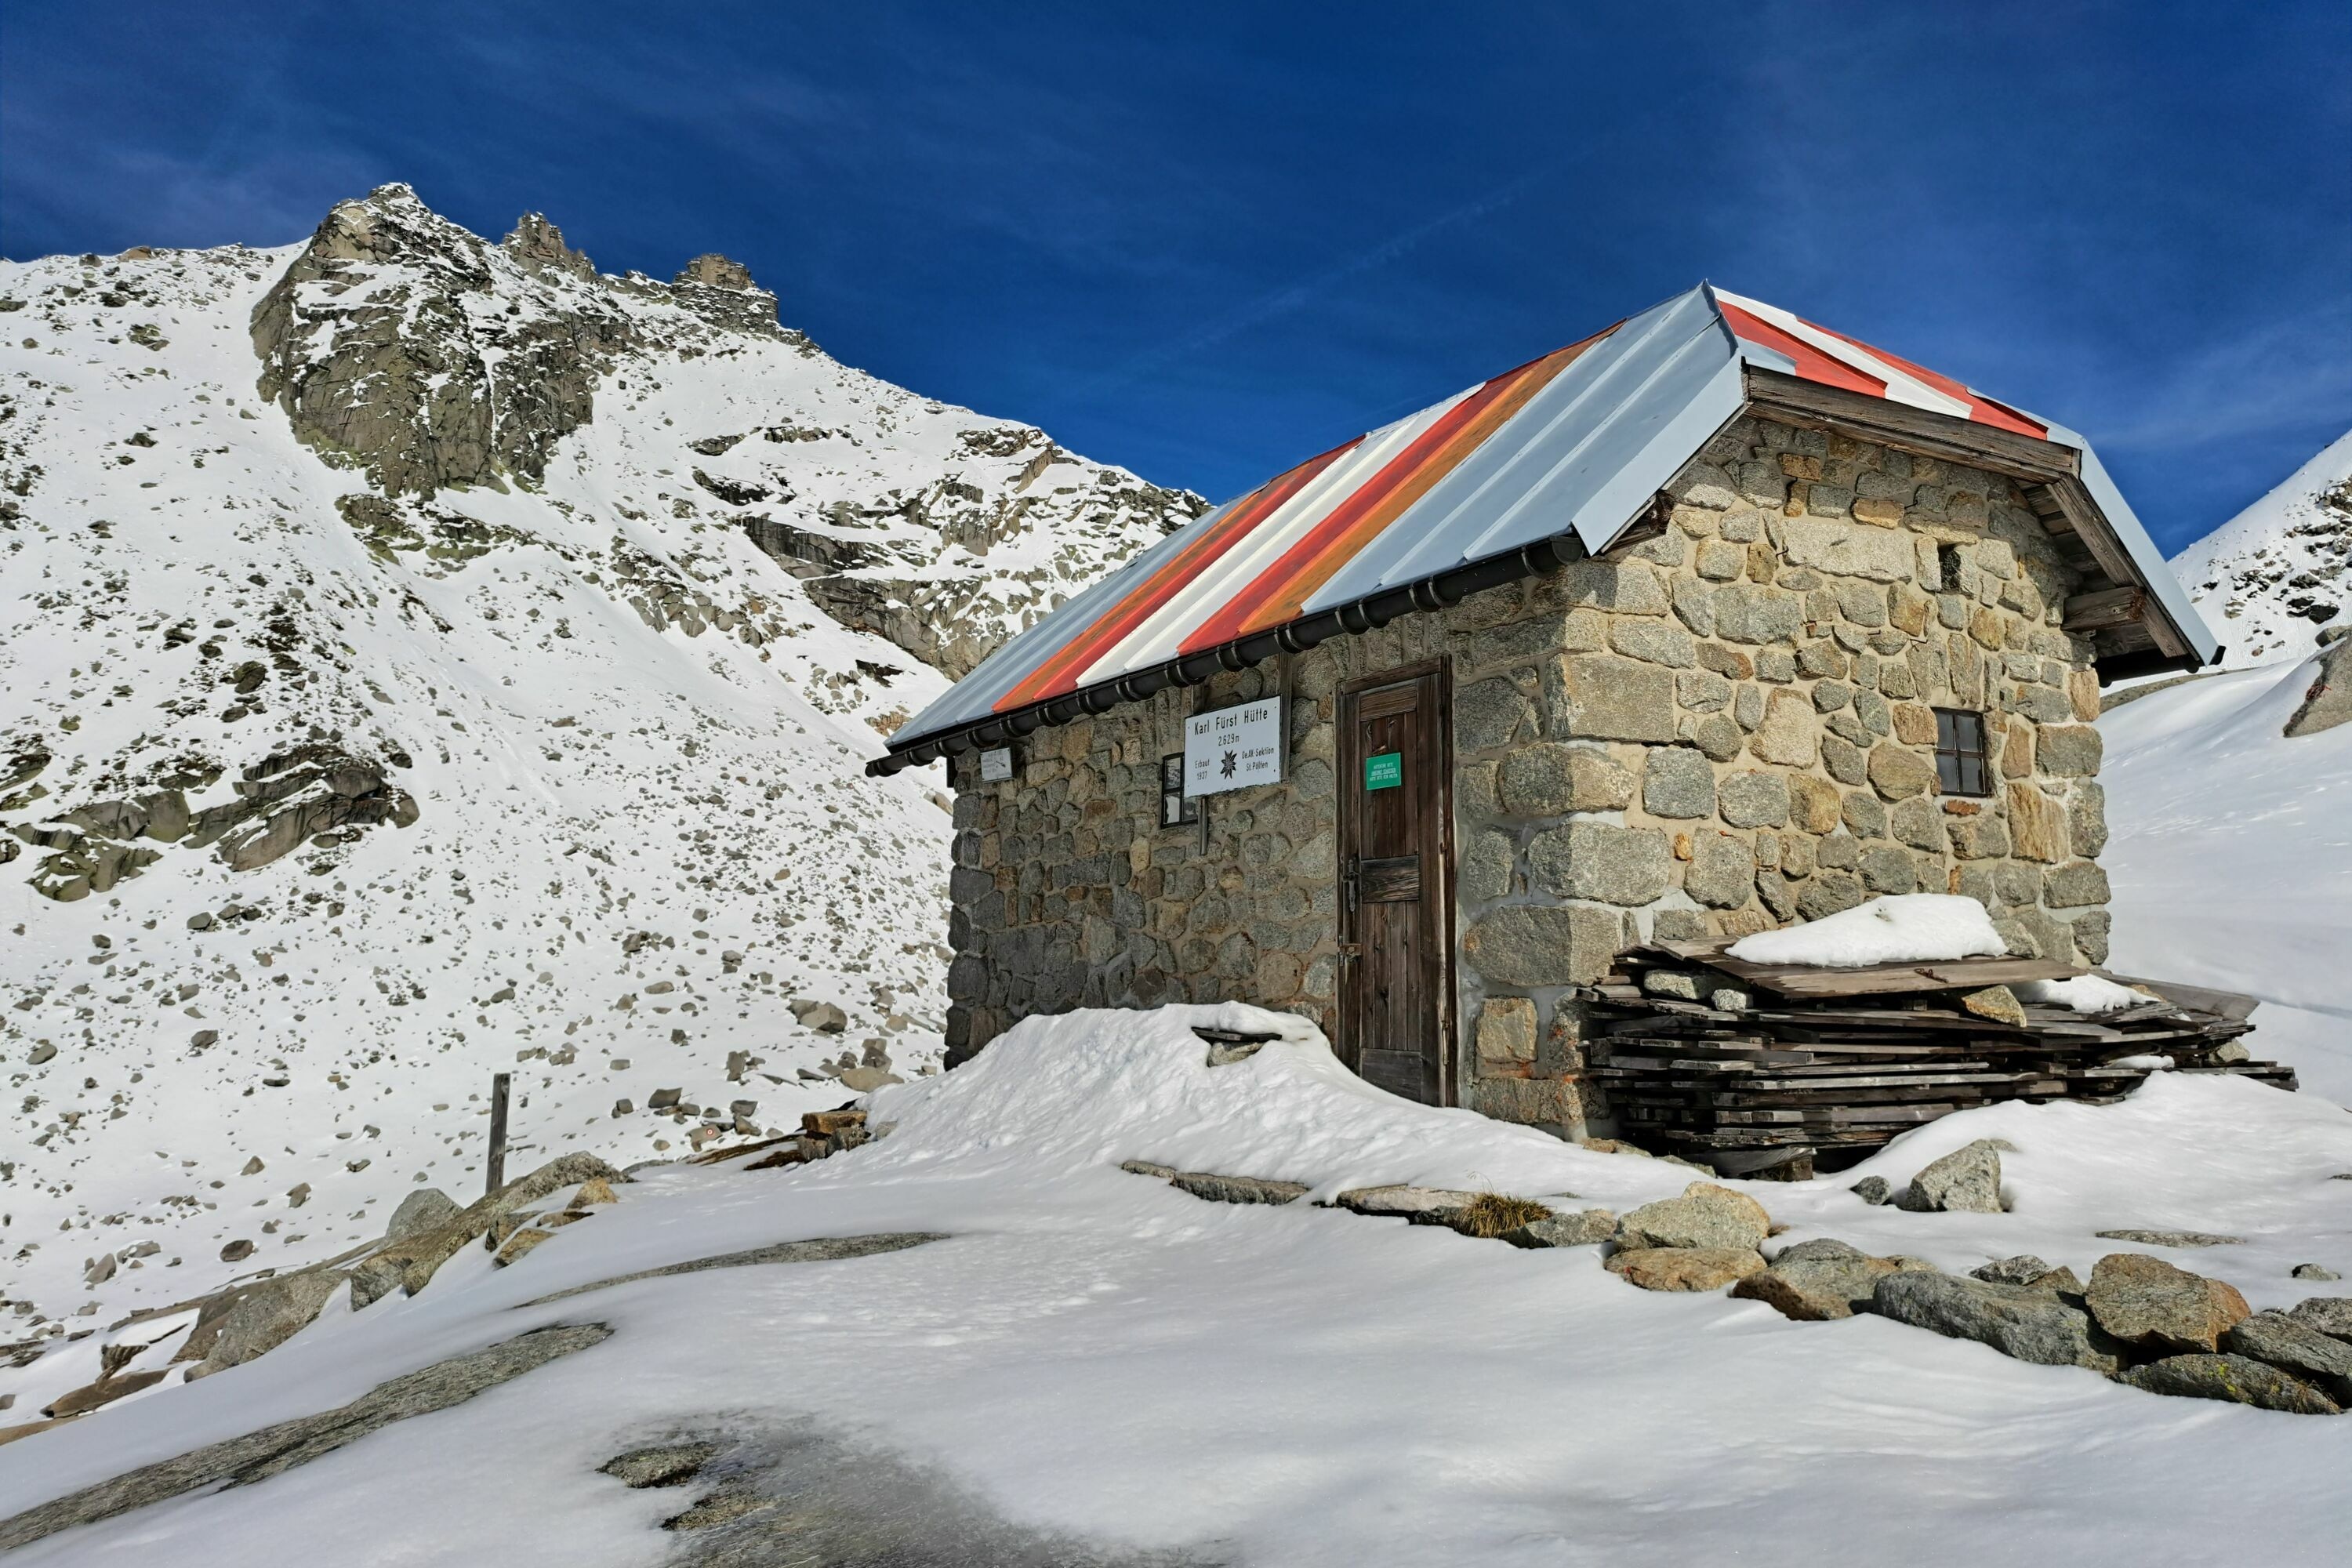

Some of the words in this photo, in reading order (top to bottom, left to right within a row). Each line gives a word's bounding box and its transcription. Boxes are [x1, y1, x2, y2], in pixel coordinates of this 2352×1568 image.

[1194, 720, 1210, 735] Karl
[1216, 713, 1237, 731] Fürst
[1244, 708, 1268, 724] Hütte
[1195, 758, 1210, 769] Erbaut
